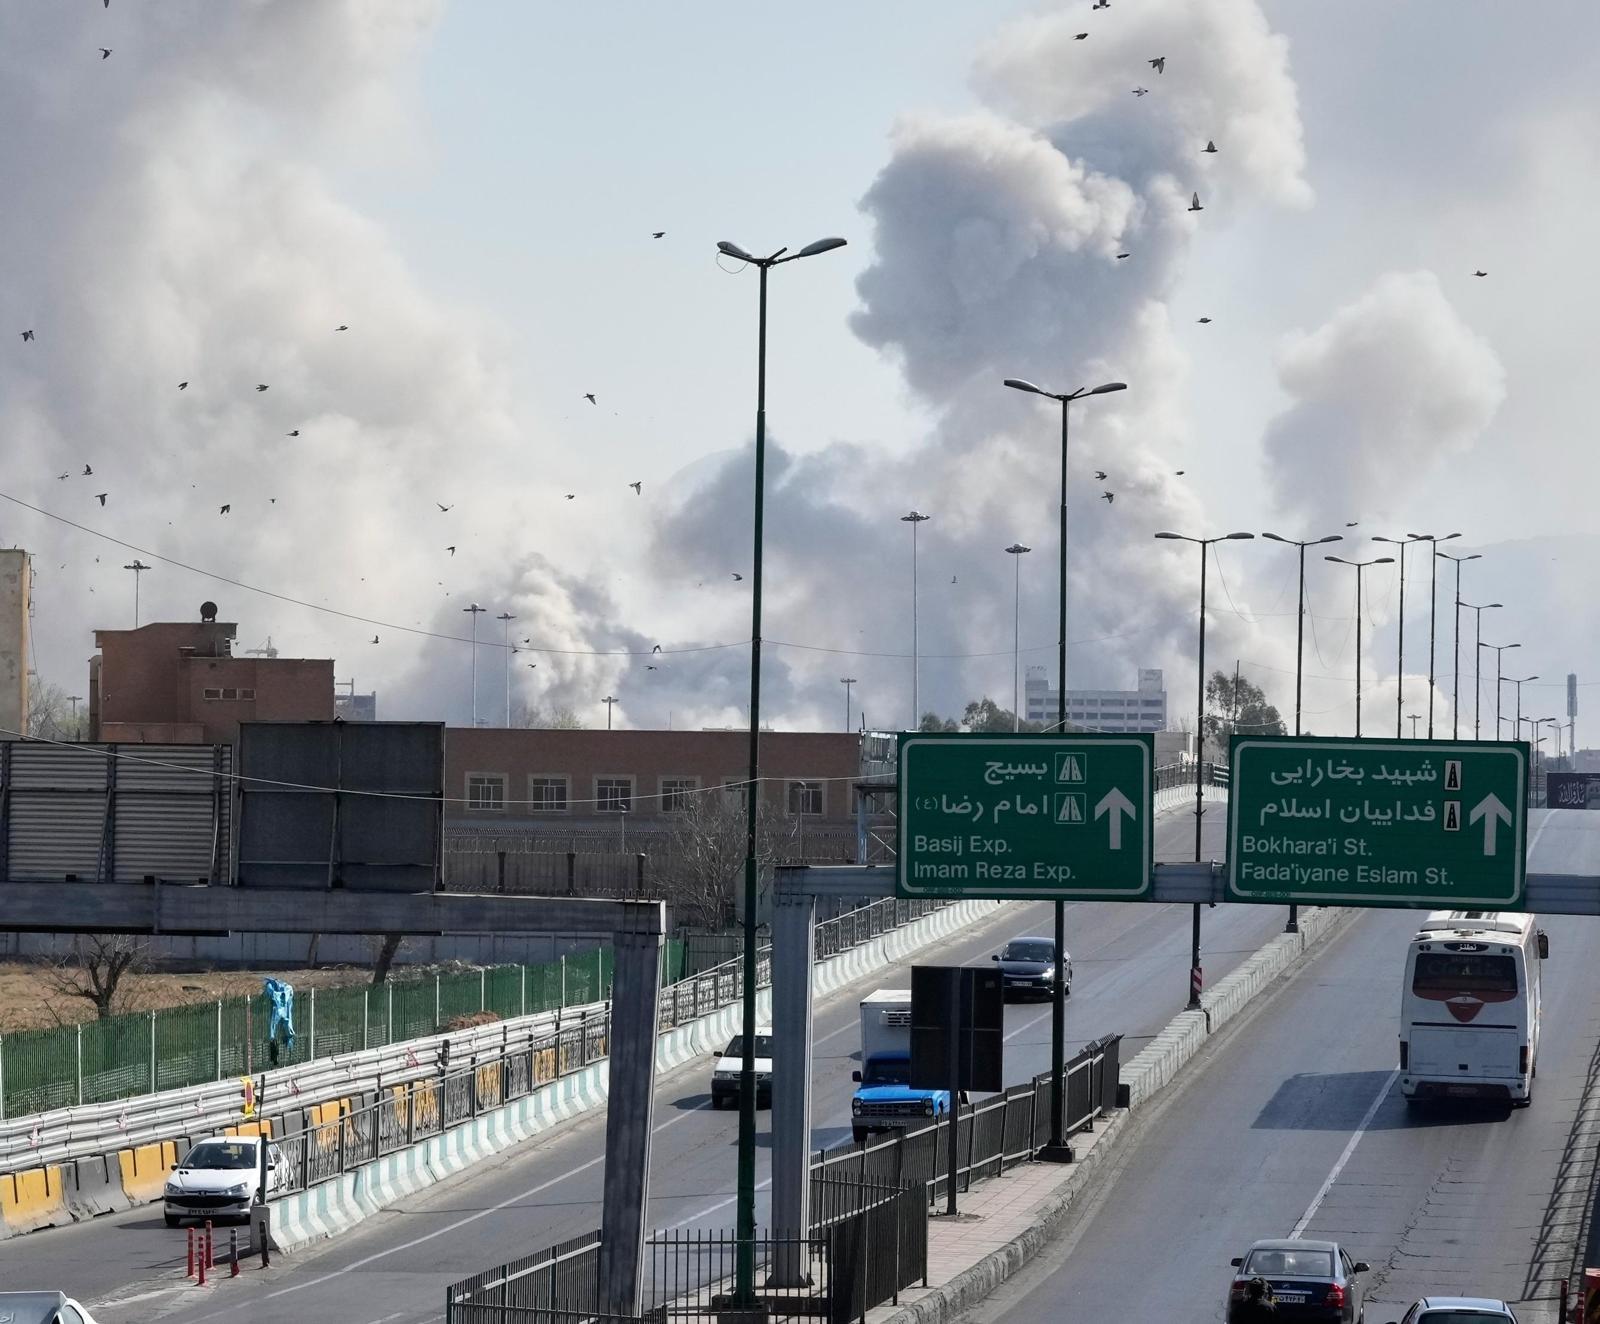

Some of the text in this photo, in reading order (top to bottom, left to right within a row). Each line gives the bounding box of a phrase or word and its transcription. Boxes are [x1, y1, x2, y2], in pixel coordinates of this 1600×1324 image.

[984, 761, 1048, 785] بسیج
[1270, 758, 1437, 787] شهید بخارایی
[993, 795, 1048, 823] امام
[1260, 798, 1437, 826] فداییان اسلام
[914, 835, 1012, 856] Basij Exp.
[1242, 835, 1372, 856] Bokhara'i St.
[914, 862, 1076, 882] Imam Reza Exp.
[1241, 862, 1454, 885] Fada'iyane Eslam St.
